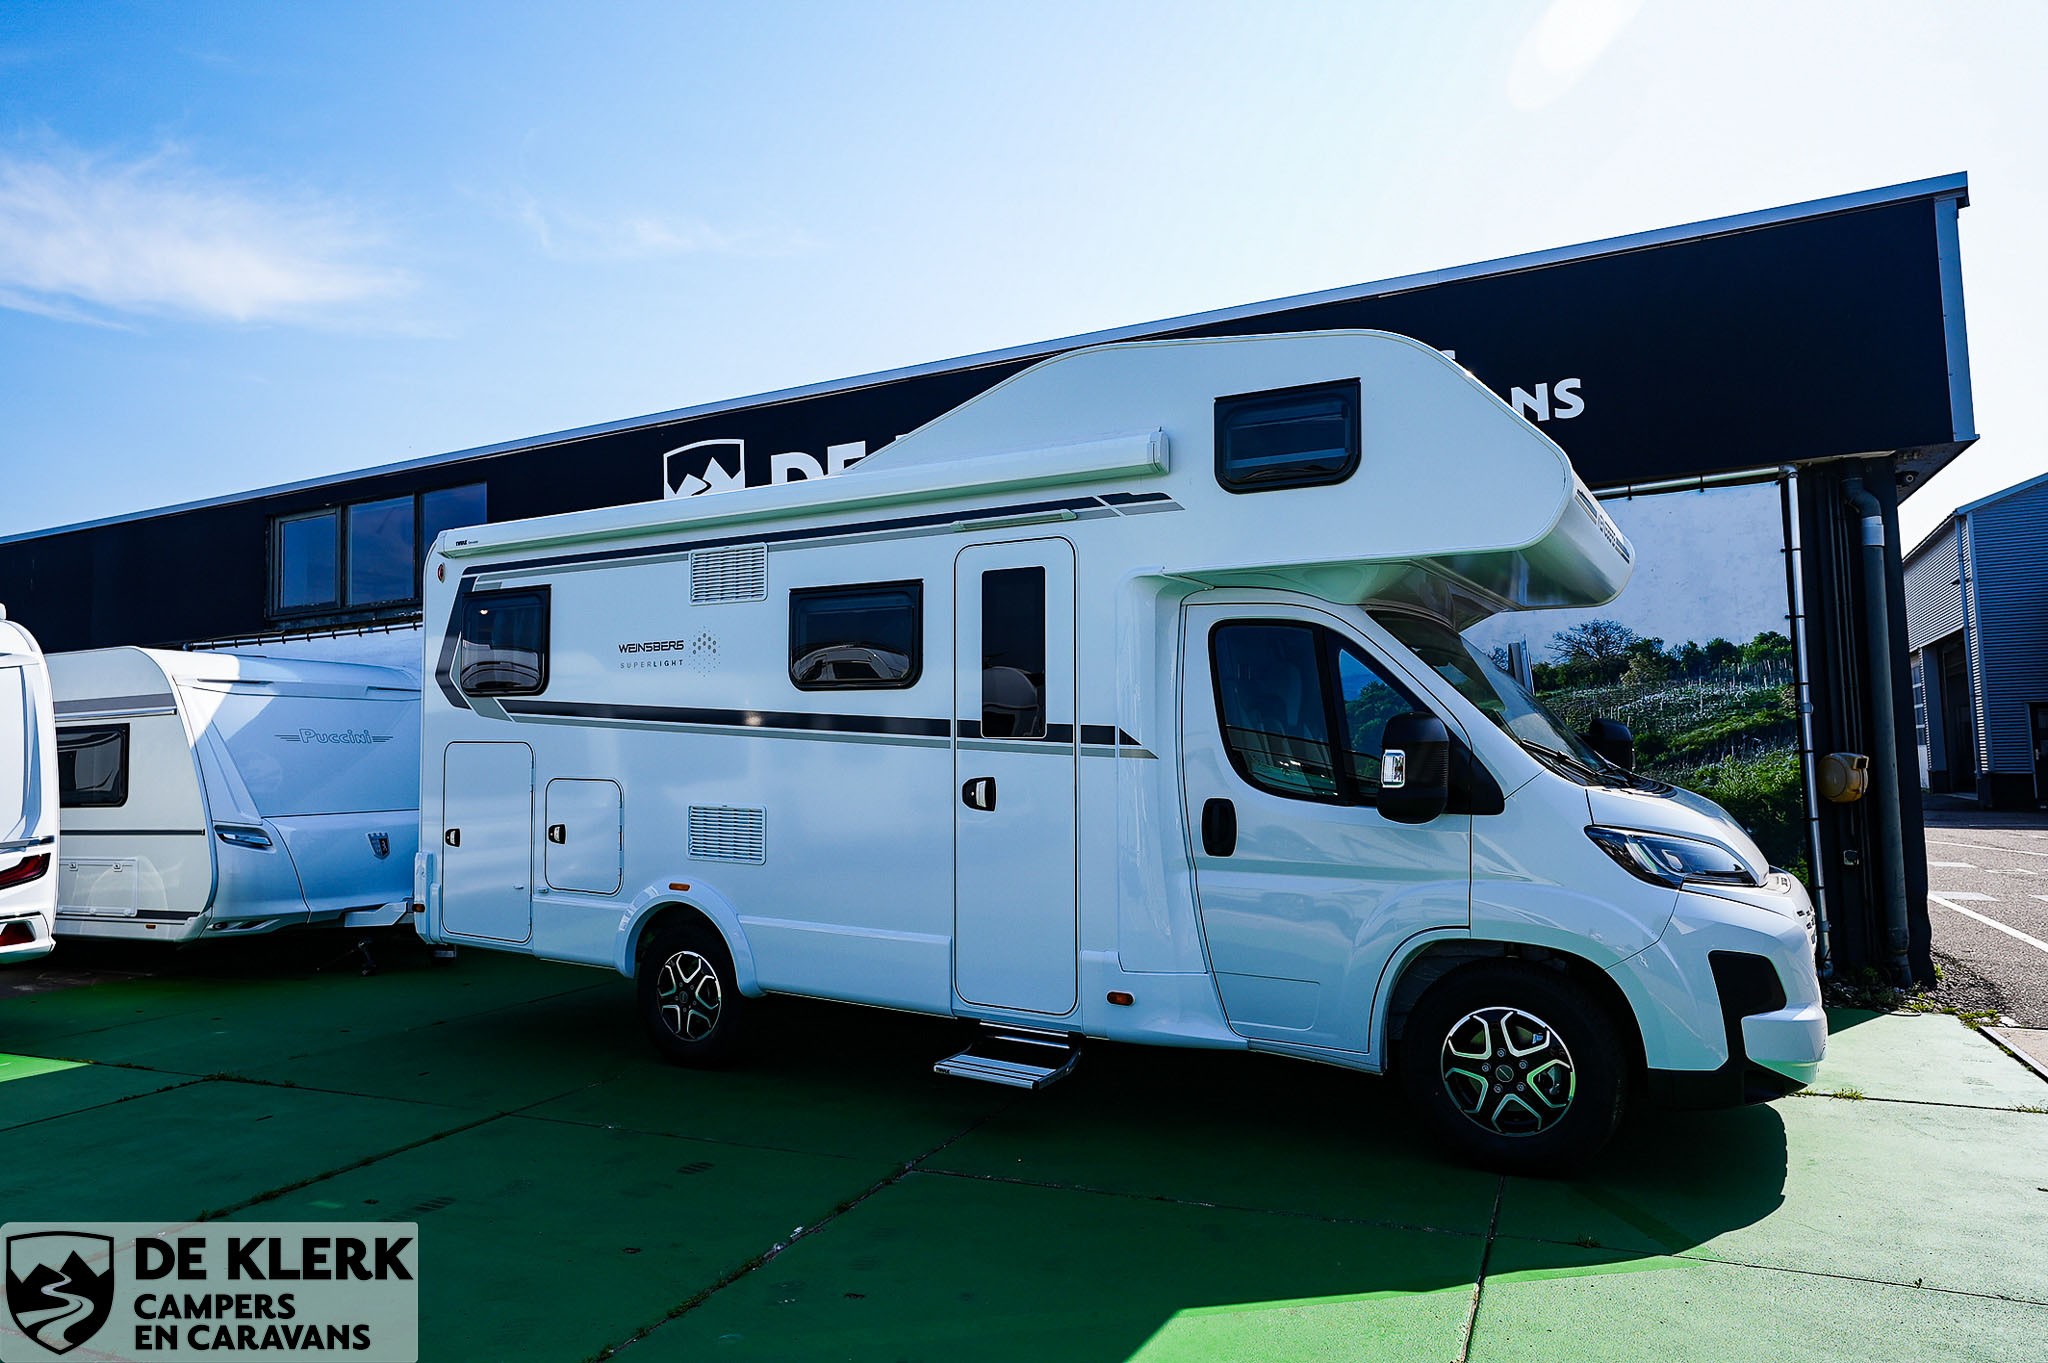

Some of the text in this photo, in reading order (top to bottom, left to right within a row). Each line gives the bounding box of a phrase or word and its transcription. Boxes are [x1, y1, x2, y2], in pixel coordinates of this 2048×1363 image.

[618, 640, 684, 653] WEINSBERG
[620, 659, 683, 669] SUPERLIGHT
[299, 728, 372, 743] Puccini
